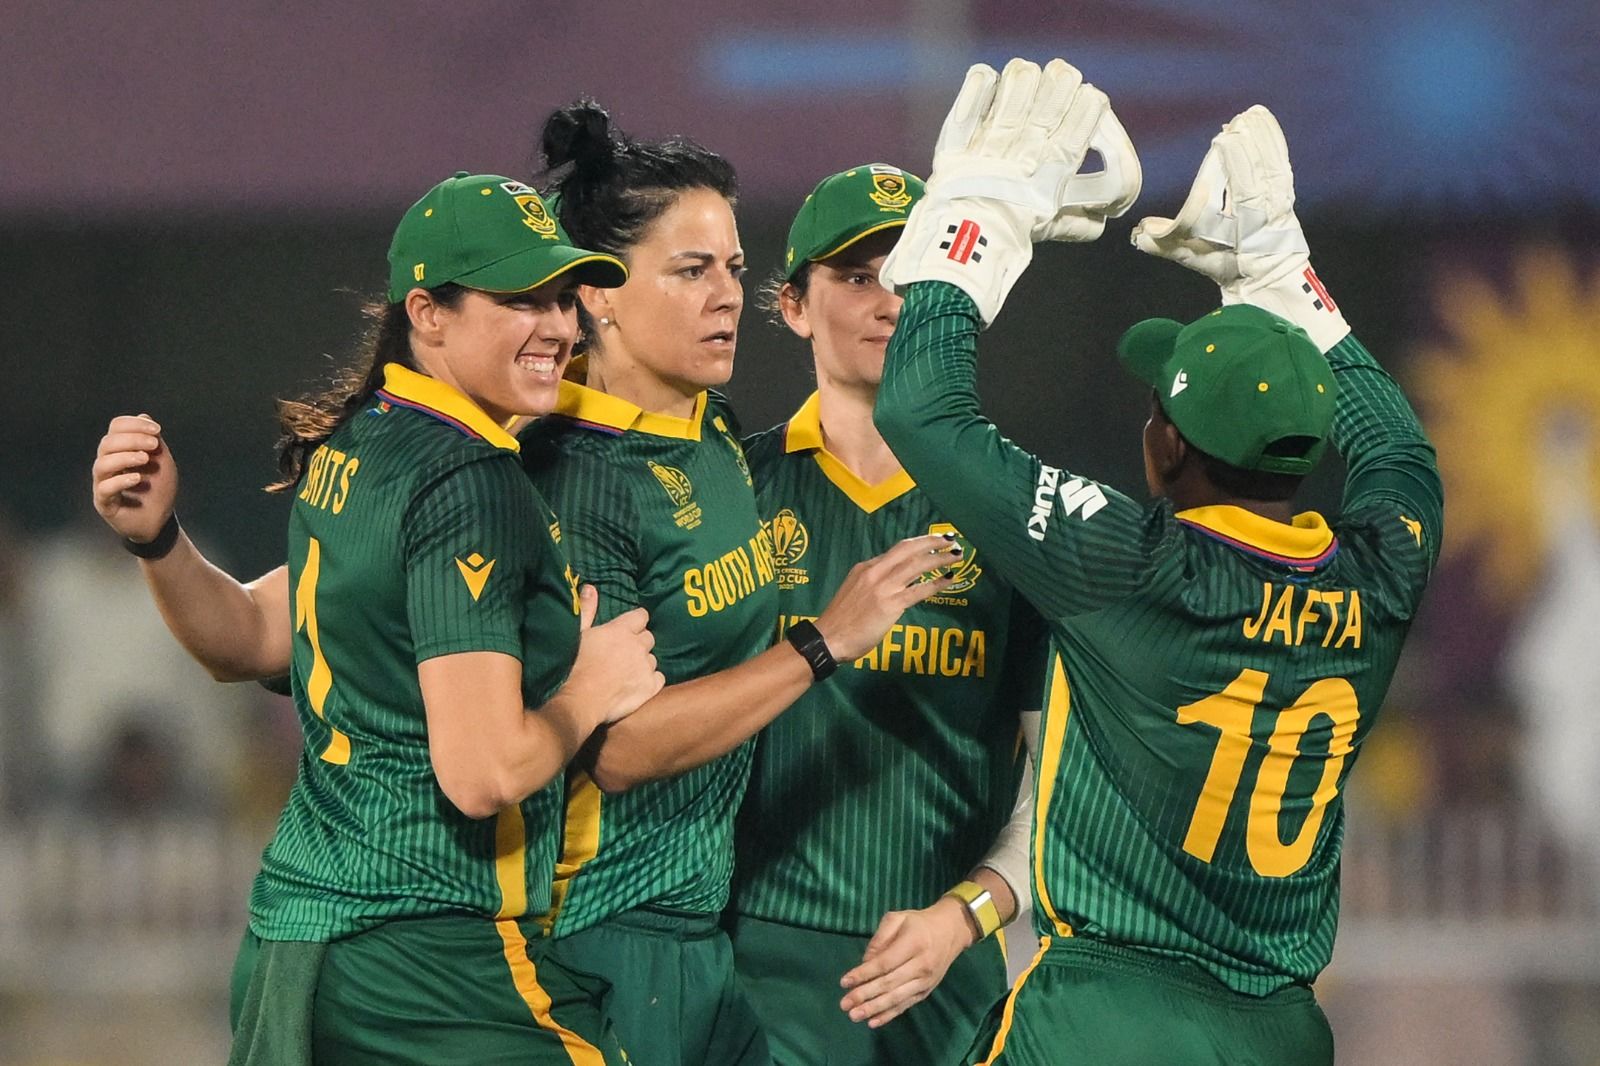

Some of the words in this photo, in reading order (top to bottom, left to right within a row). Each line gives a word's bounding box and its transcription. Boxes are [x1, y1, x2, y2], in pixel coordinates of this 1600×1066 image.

[1027, 465, 1060, 541] ZUKI
[684, 546, 756, 617] SOUTH
[787, 574, 810, 585] CUP
[1243, 582, 1363, 648] JAFTA
[1176, 668, 1360, 878] 10
